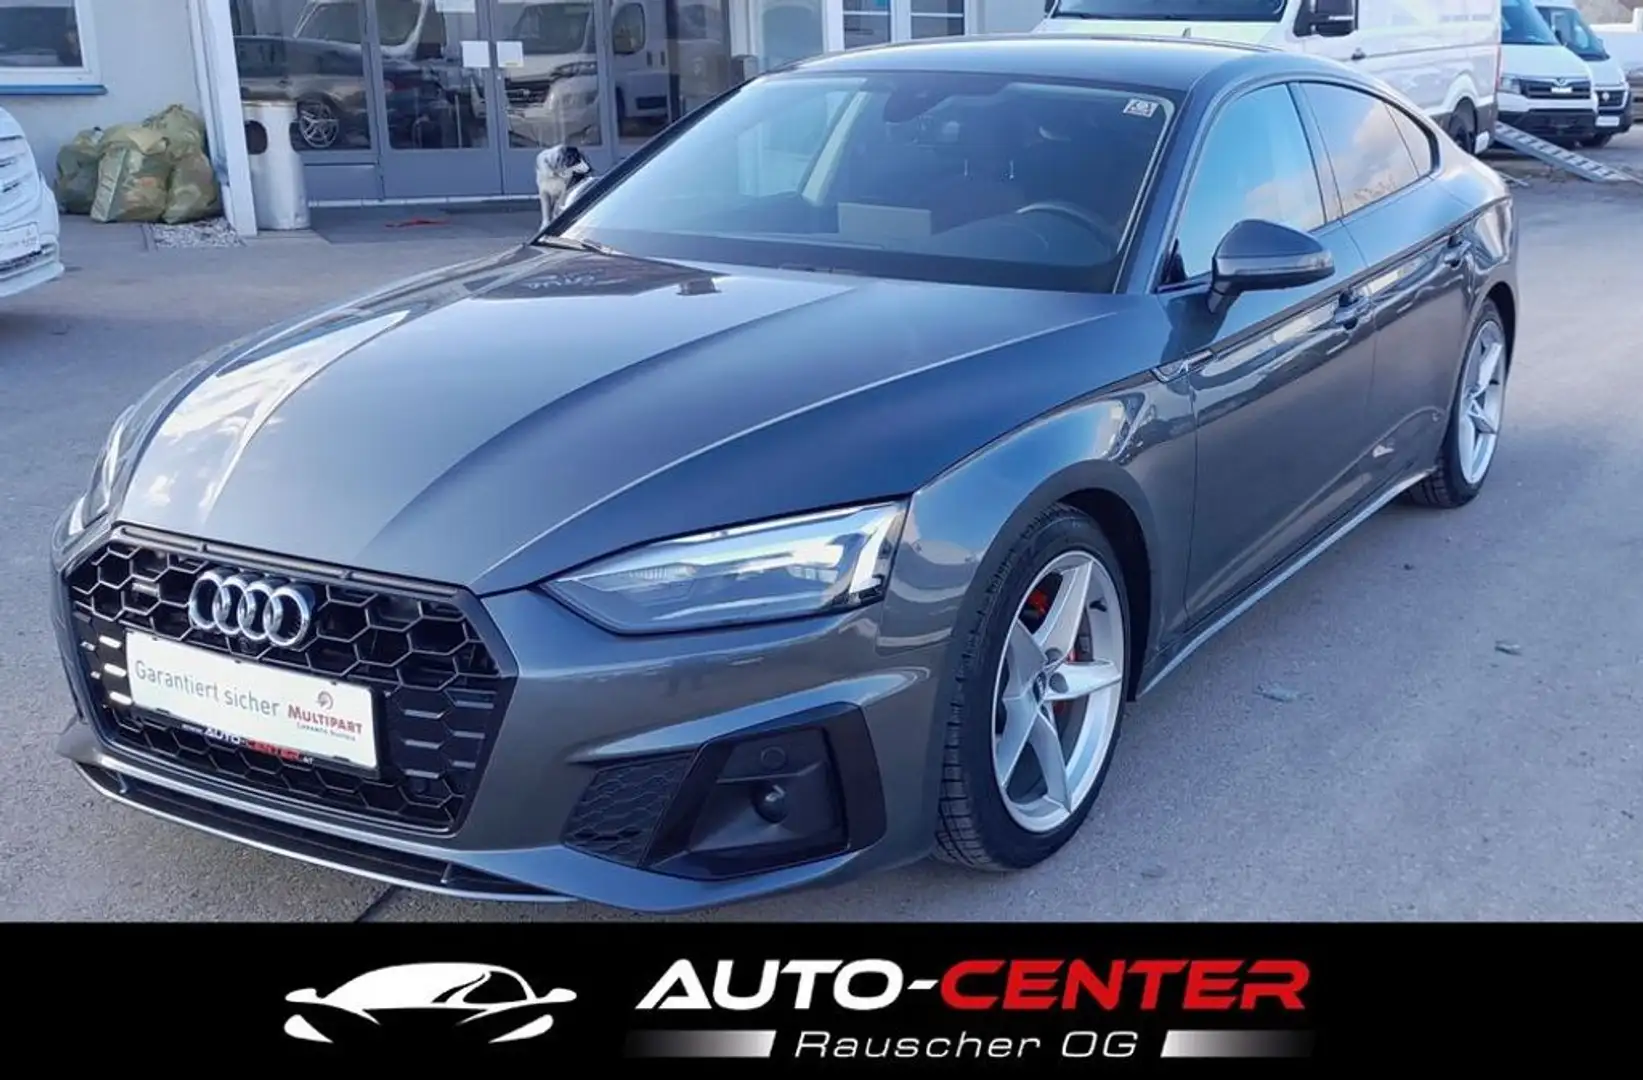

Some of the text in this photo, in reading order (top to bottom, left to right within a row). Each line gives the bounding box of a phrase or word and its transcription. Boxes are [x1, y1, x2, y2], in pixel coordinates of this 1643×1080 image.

[135, 659, 280, 716] Garantiert sicher
[287, 703, 363, 735] MULTIPART
